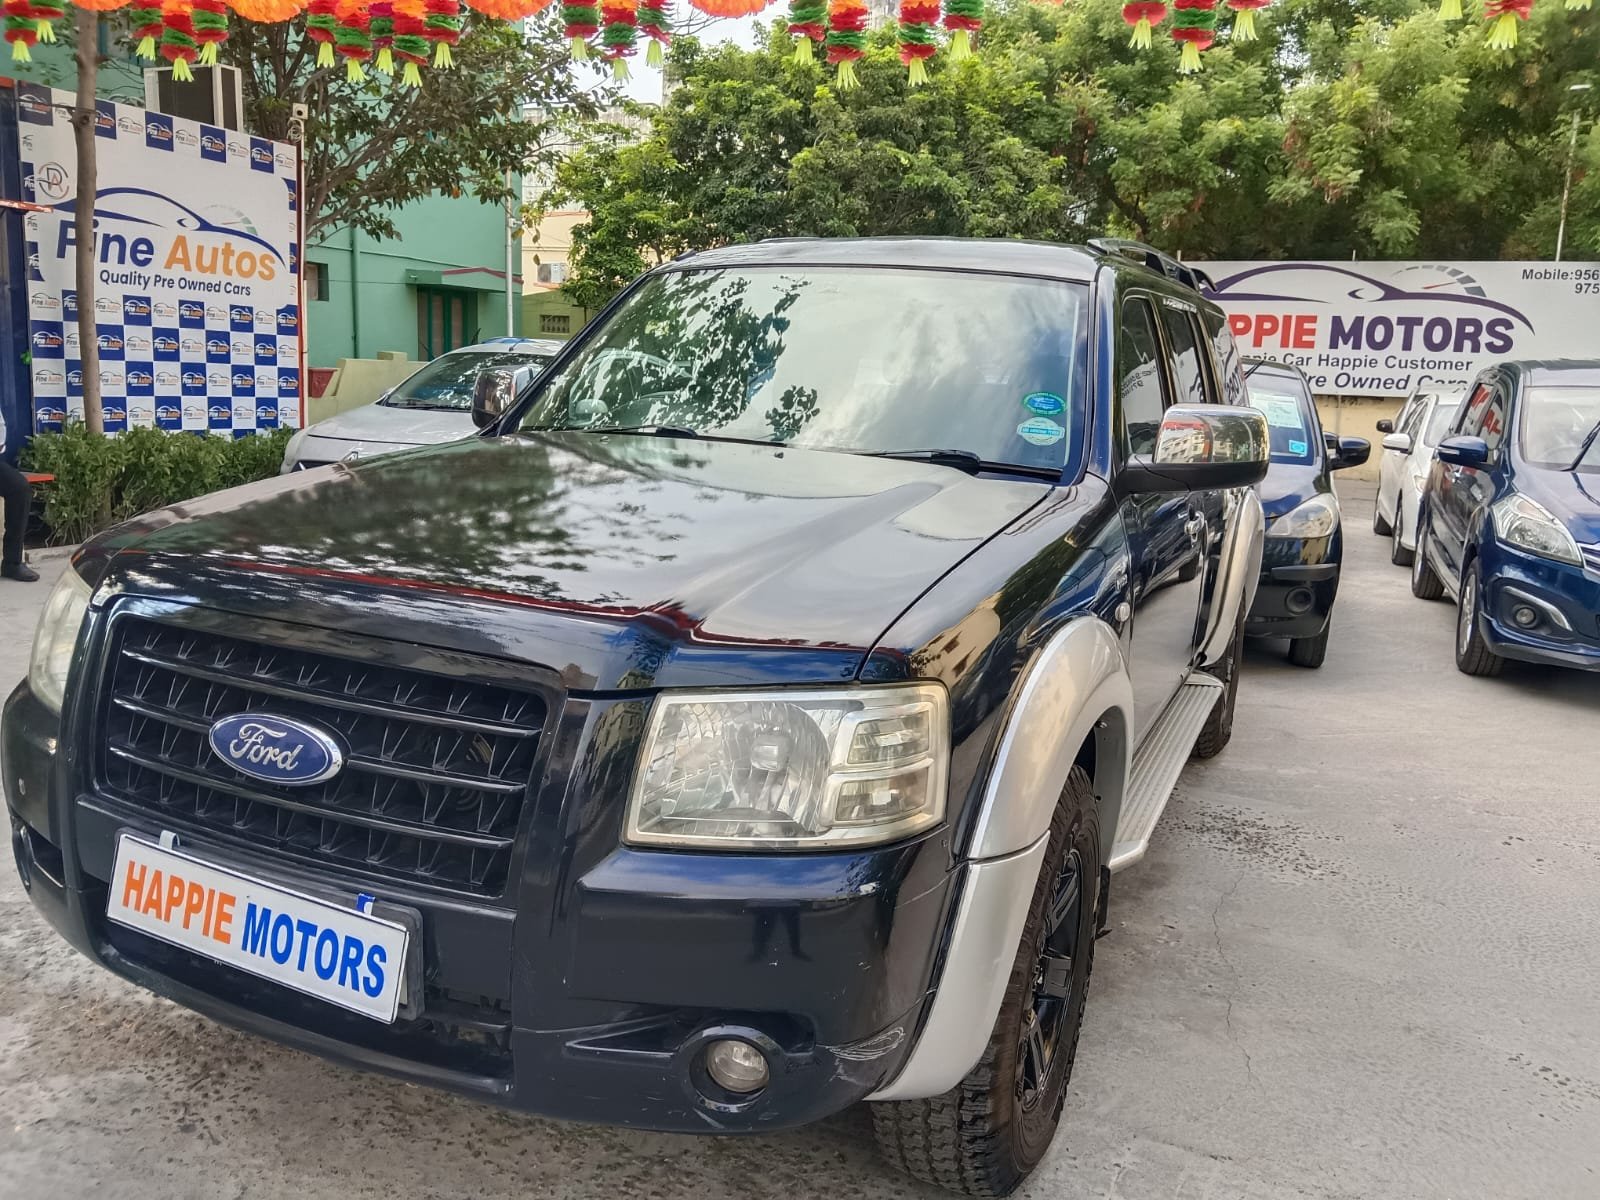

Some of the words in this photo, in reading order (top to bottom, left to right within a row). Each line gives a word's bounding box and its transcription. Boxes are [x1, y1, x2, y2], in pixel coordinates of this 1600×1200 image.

[164, 235, 276, 281] Autos
[100, 269, 150, 291] Quality
[154, 274, 175, 288] Pre
[178, 277, 221, 293] Owned
[224, 281, 251, 296] Cars
[1574, 282, 1600, 295] 975
[1229, 314, 1318, 349] PPIE
[1329, 315, 1515, 354] MOTORS
[1283, 353, 1312, 366] Car
[1318, 354, 1379, 371] Happie
[1384, 355, 1473, 371] Customer
[1335, 372, 1411, 390] Owned
[229, 723, 304, 771] Ford
[122, 860, 237, 945] HAPPIE
[241, 902, 387, 998] MOTORS
